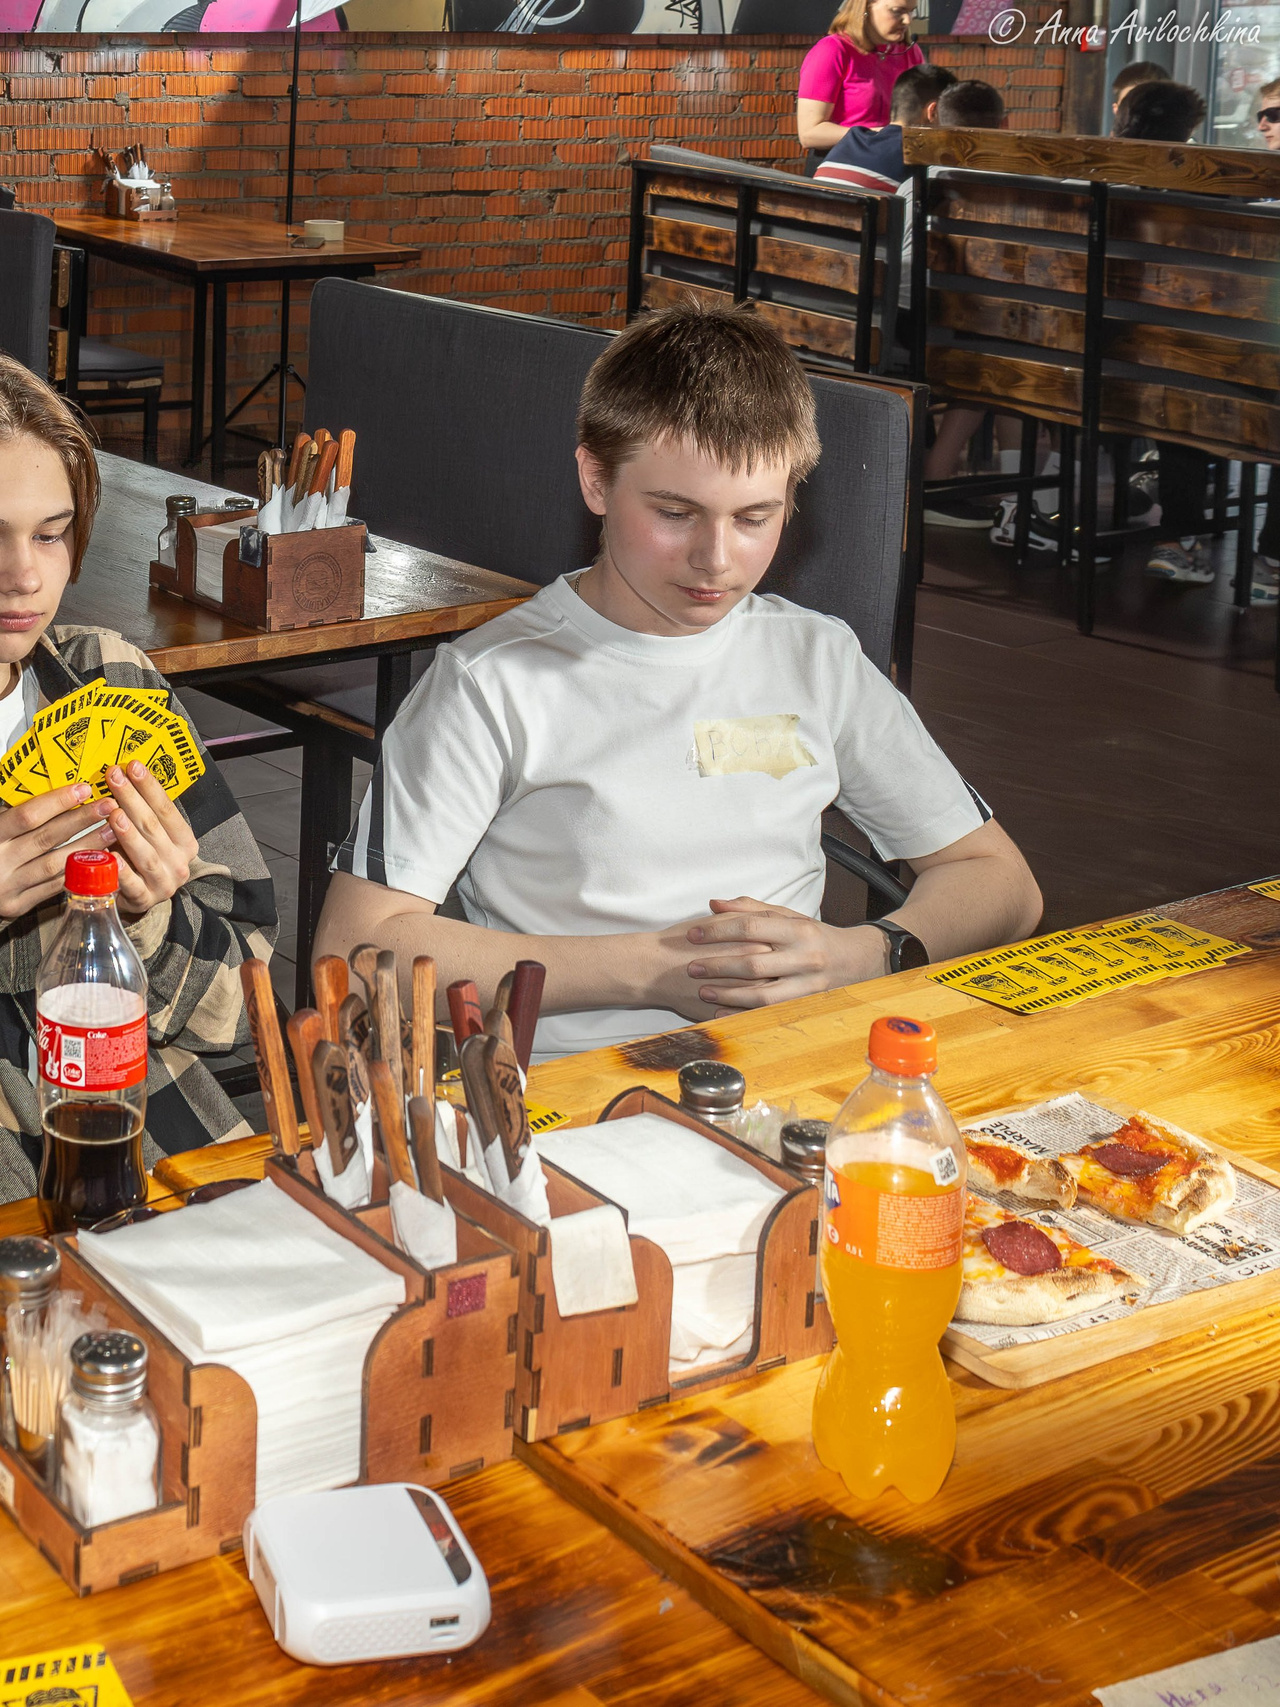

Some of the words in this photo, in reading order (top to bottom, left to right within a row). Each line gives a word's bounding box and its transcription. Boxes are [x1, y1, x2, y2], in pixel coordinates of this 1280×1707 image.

[1000, 985, 1039, 1001] БУНКЕР
[87, 1030, 108, 1040] Coke
[989, 1121, 1050, 1155] MARPLE
